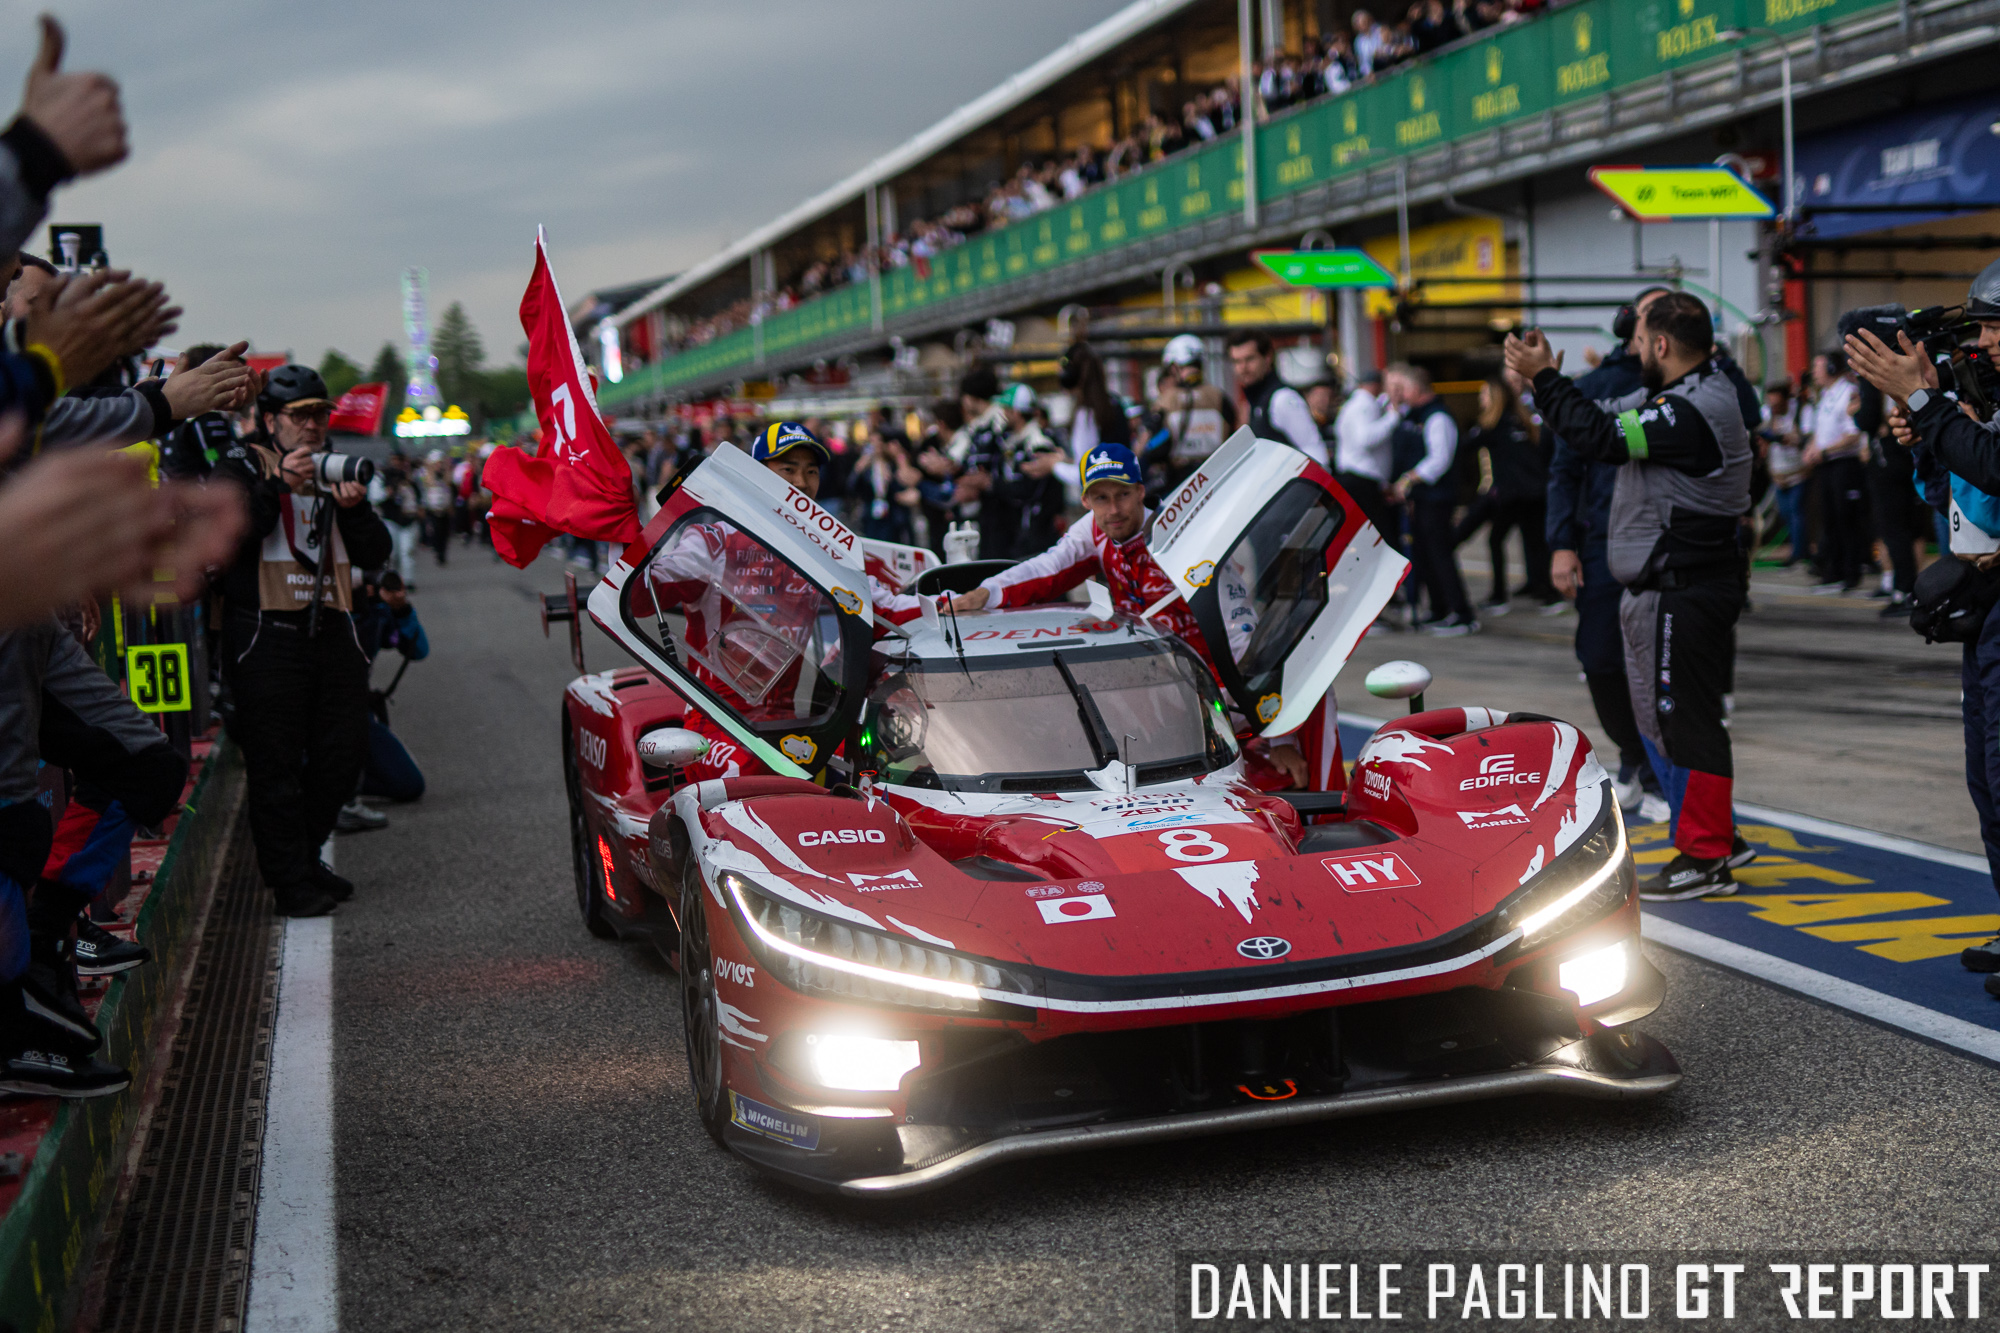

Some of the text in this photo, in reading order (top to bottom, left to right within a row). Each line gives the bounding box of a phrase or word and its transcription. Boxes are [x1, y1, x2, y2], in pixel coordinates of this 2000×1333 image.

[1157, 472, 1208, 531] TOYOTA
[784, 486, 855, 551] TOYOTA
[1952, 510, 1961, 532] 9
[963, 617, 1119, 641] DENSO
[135, 650, 184, 707] 38
[580, 727, 607, 771] DENSO
[1364, 769, 1385, 792] TOYOTA
[1459, 772, 1541, 791] EDIFICE
[1117, 804, 1192, 818] ZENT
[1467, 817, 1531, 830] MARELLI
[798, 829, 886, 847] CASIO
[1157, 828, 1230, 863] 8
[1331, 857, 1400, 886] HY
[856, 882, 923, 893] MARELLI
[1027, 888, 1062, 898] FIA
[747, 1108, 809, 1138] MICHELIN
